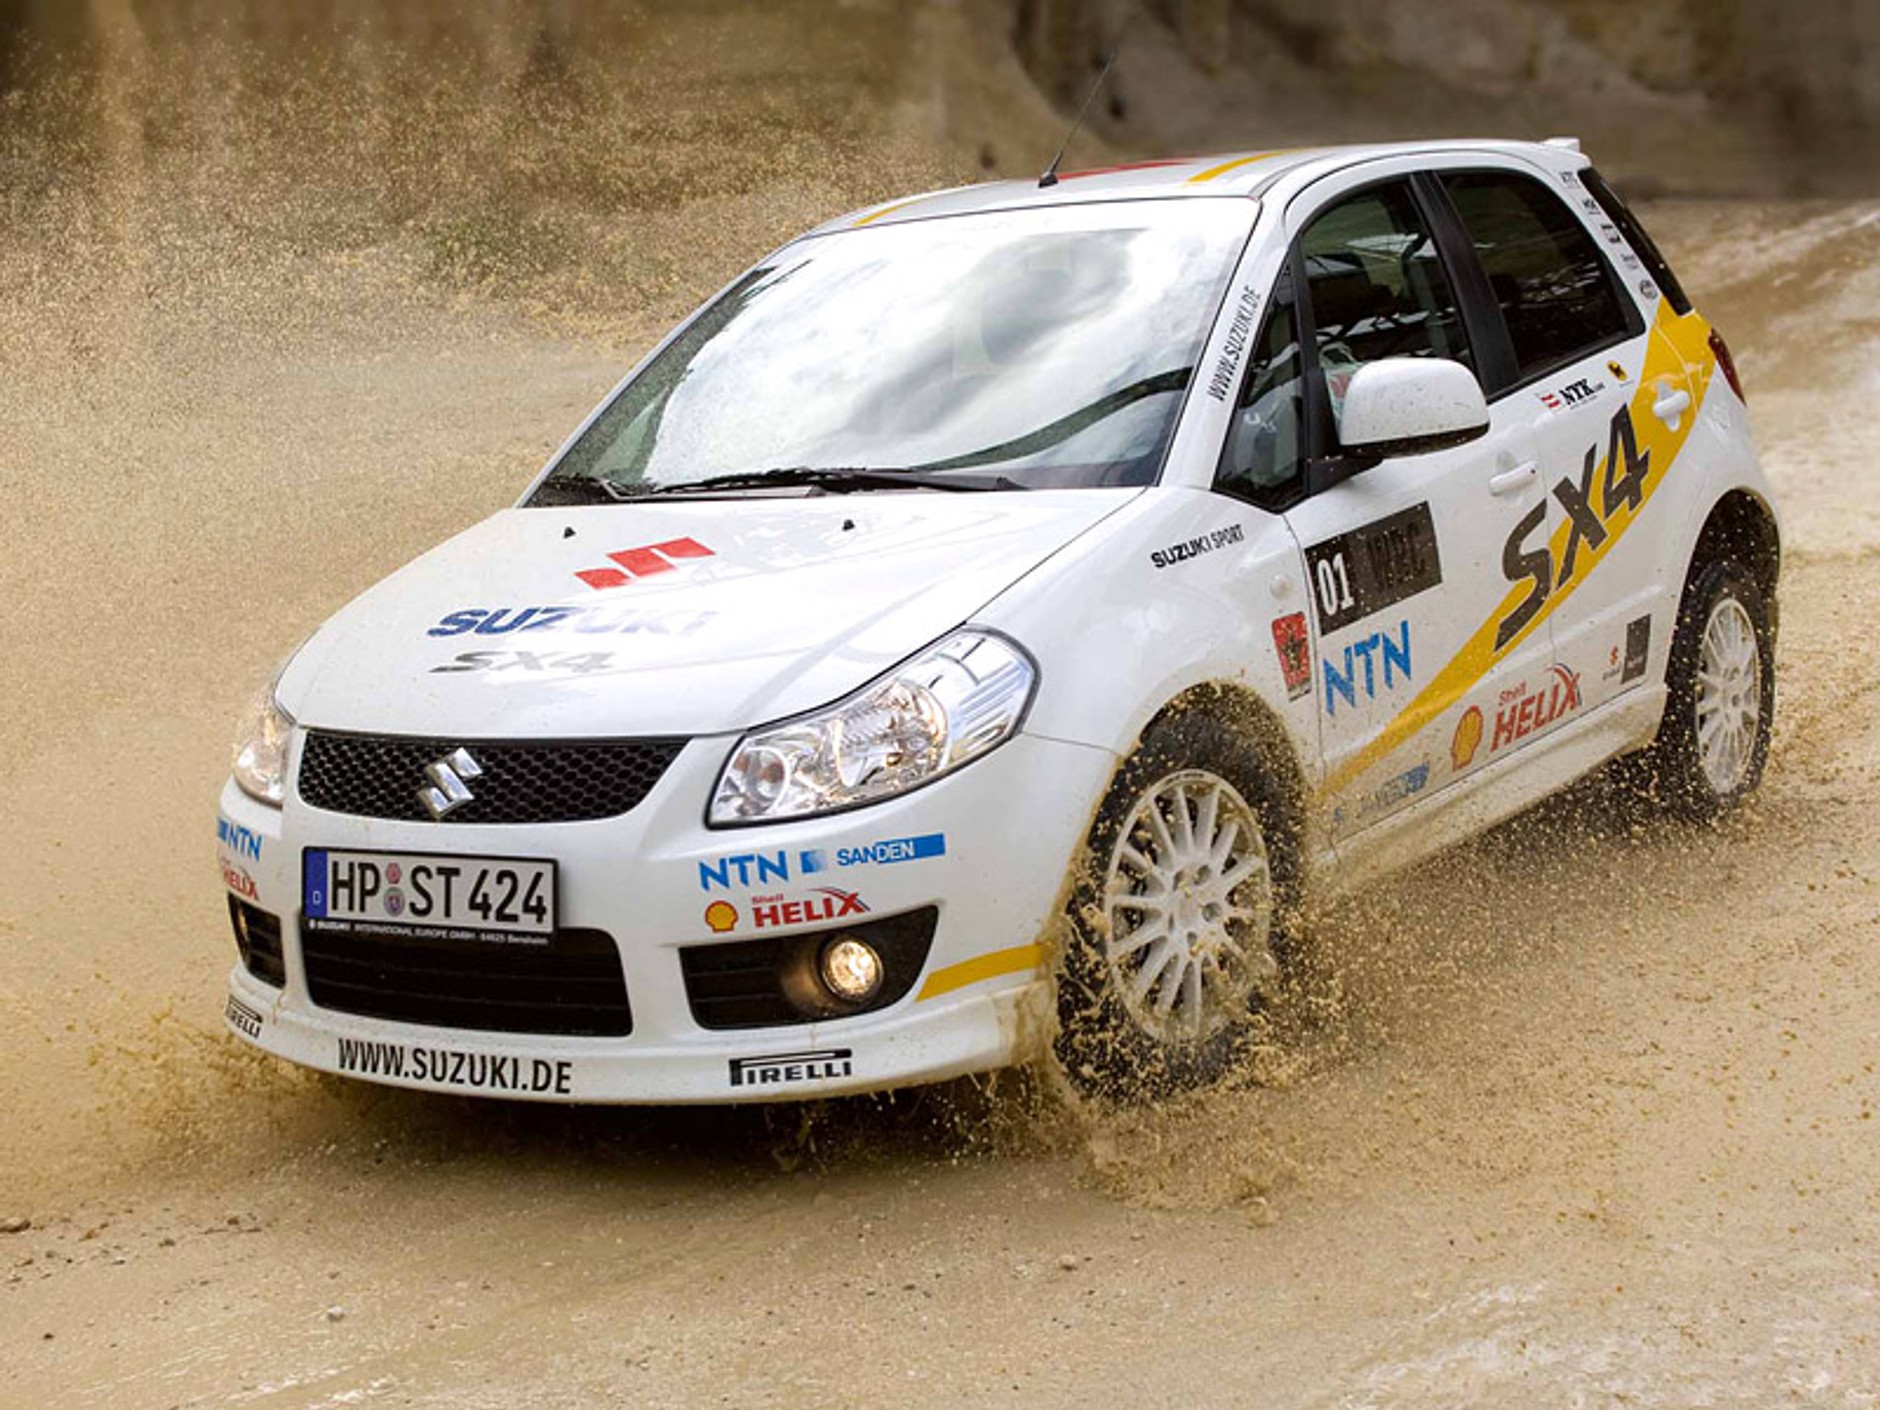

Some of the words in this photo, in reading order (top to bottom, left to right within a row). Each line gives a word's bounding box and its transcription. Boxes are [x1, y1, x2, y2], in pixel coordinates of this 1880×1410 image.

[1208, 285, 1261, 402] WWW.SUZUKI.DE
[1151, 536, 1213, 568] SUZUKI
[1210, 524, 1244, 549] SPORT
[1493, 402, 1650, 652] SX4
[1317, 552, 1355, 616] 01
[427, 606, 721, 637] SUZUKI
[428, 650, 617, 673] SX4
[1322, 619, 1412, 717] NTN
[1489, 666, 1582, 753] HELIX
[226, 825, 263, 862] NTN
[836, 840, 917, 867] SANDEN
[331, 860, 380, 912] HP
[409, 867, 460, 918] ST
[467, 869, 547, 924] 424
[698, 851, 789, 892] NTN
[753, 889, 869, 927] HELIX
[338, 1038, 572, 1094] WWW.SUZUKI.DE
[728, 1048, 852, 1087] PIRELLI
